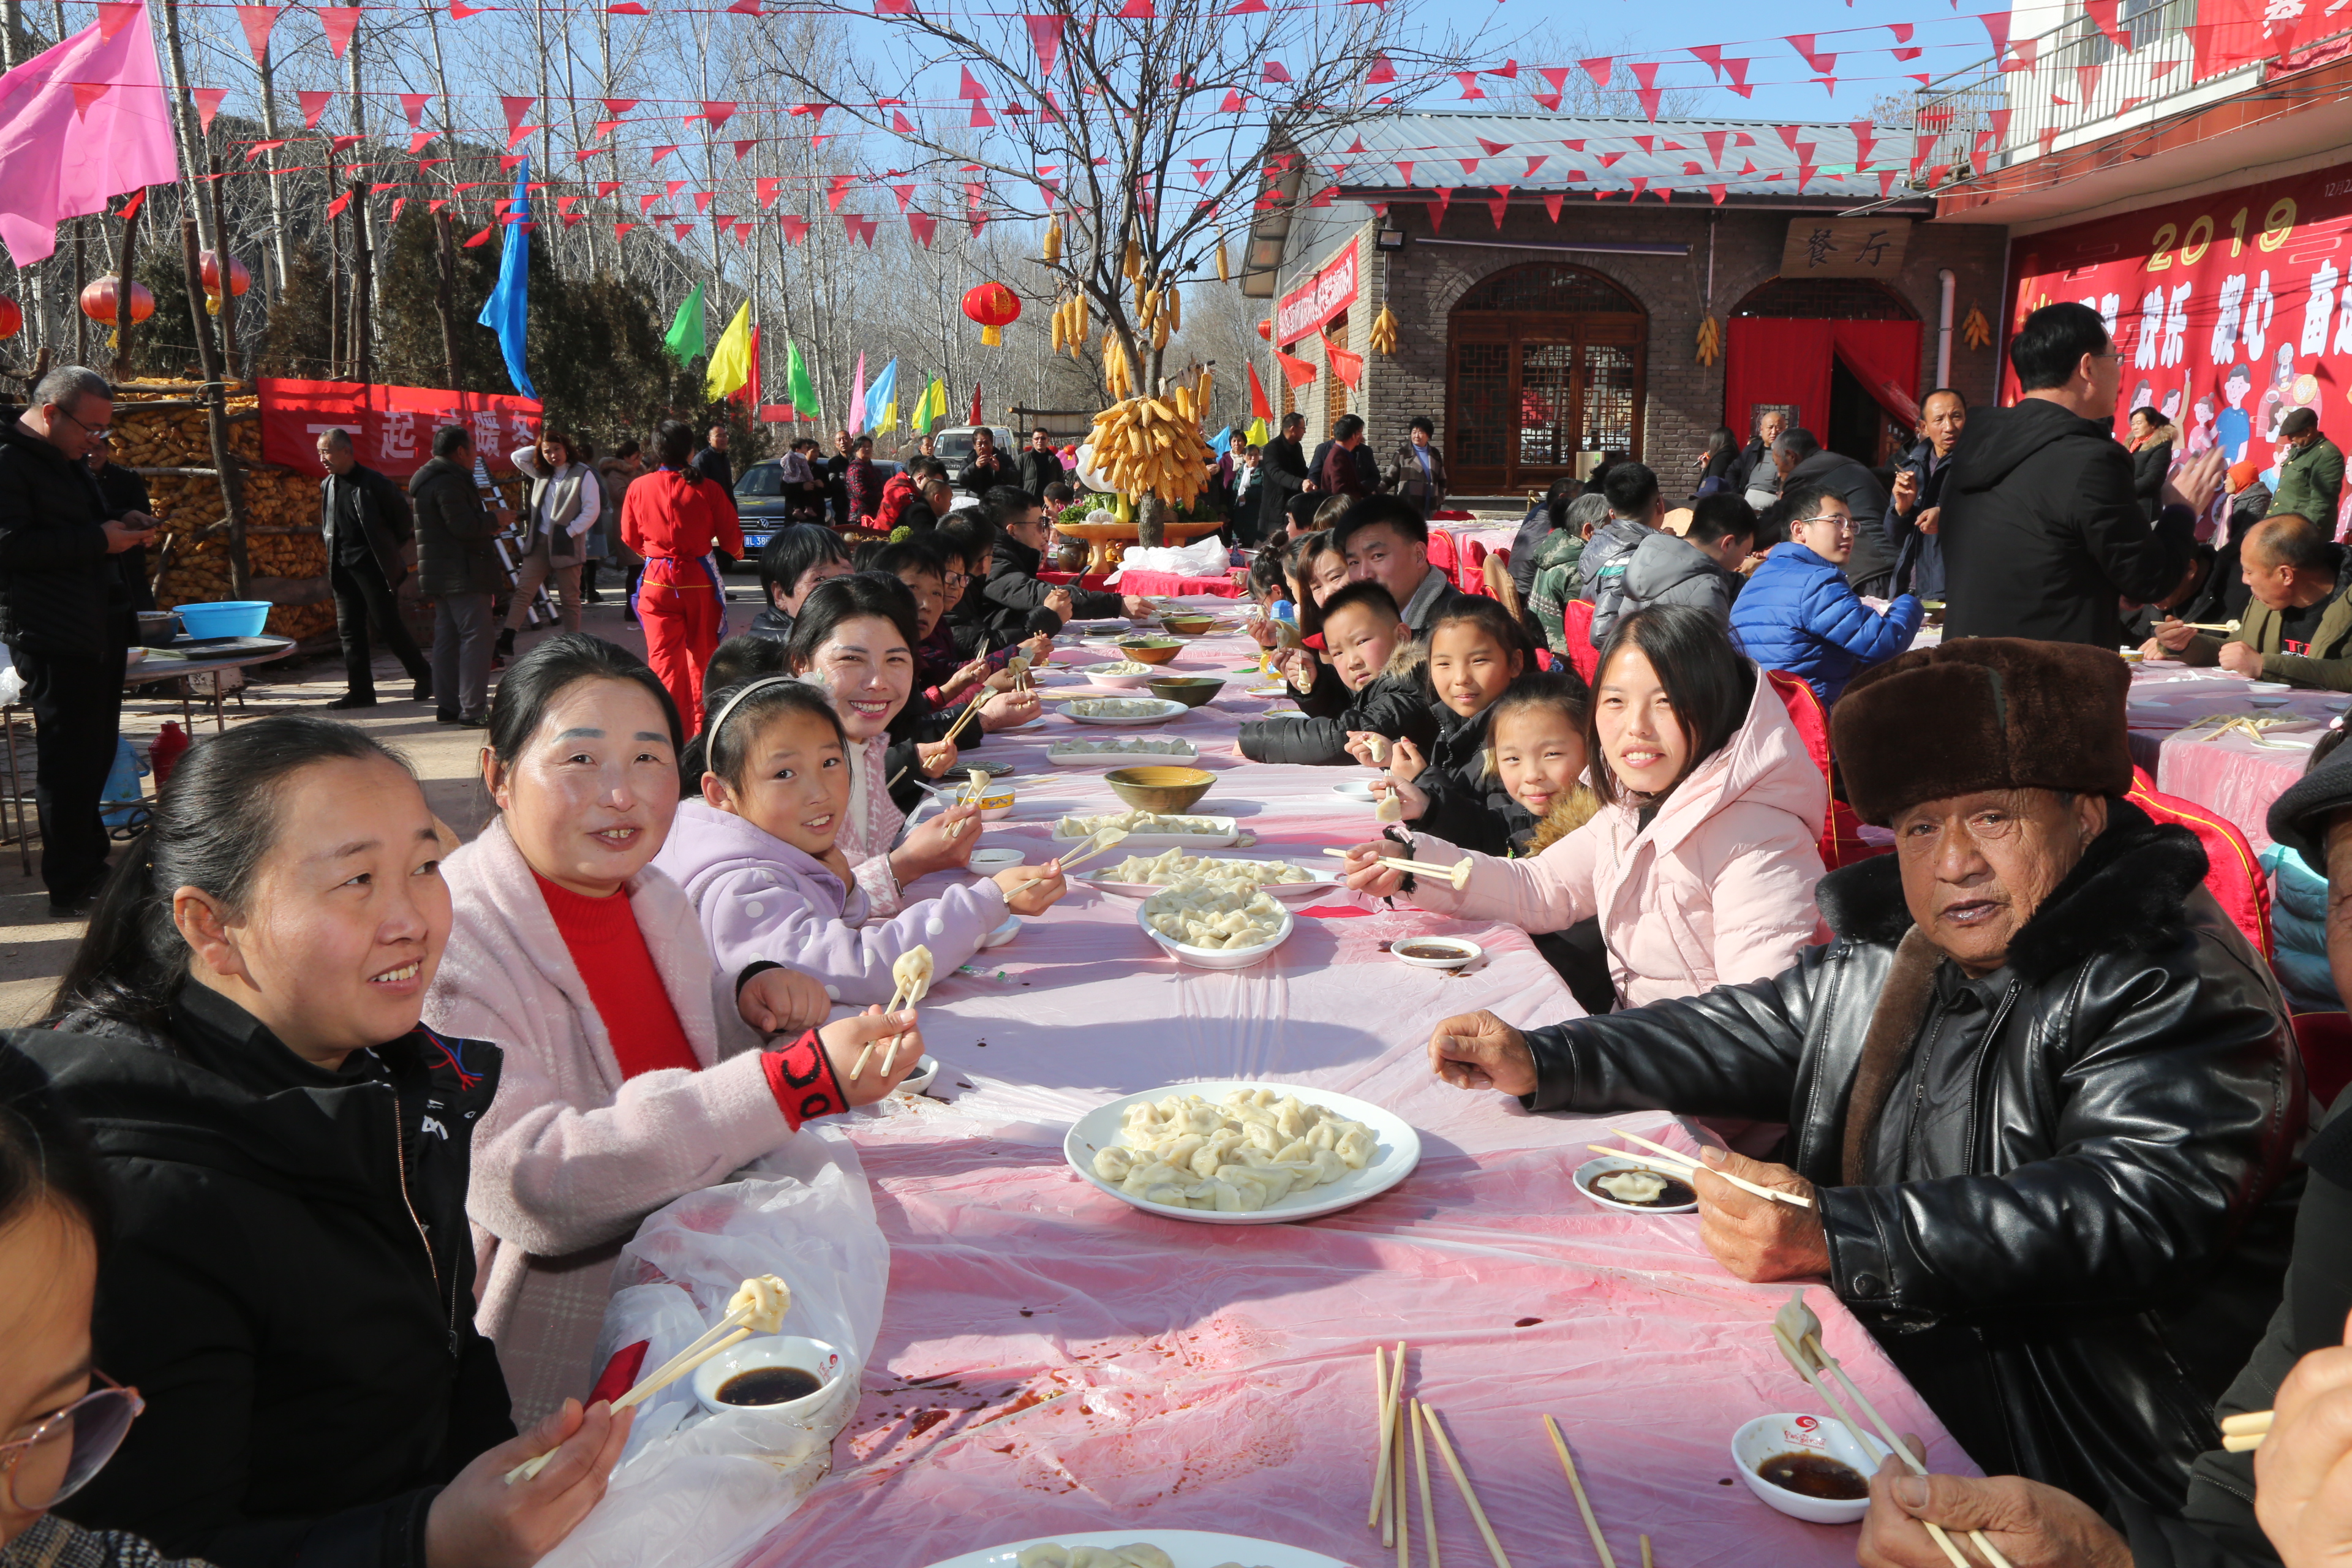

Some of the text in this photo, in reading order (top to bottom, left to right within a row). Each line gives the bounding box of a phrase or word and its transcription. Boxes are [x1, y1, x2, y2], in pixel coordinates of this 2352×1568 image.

[1801, 228, 1890, 269] 餐厅
[2146, 197, 2297, 272] 2019
[2135, 280, 2192, 371] 欢乐
